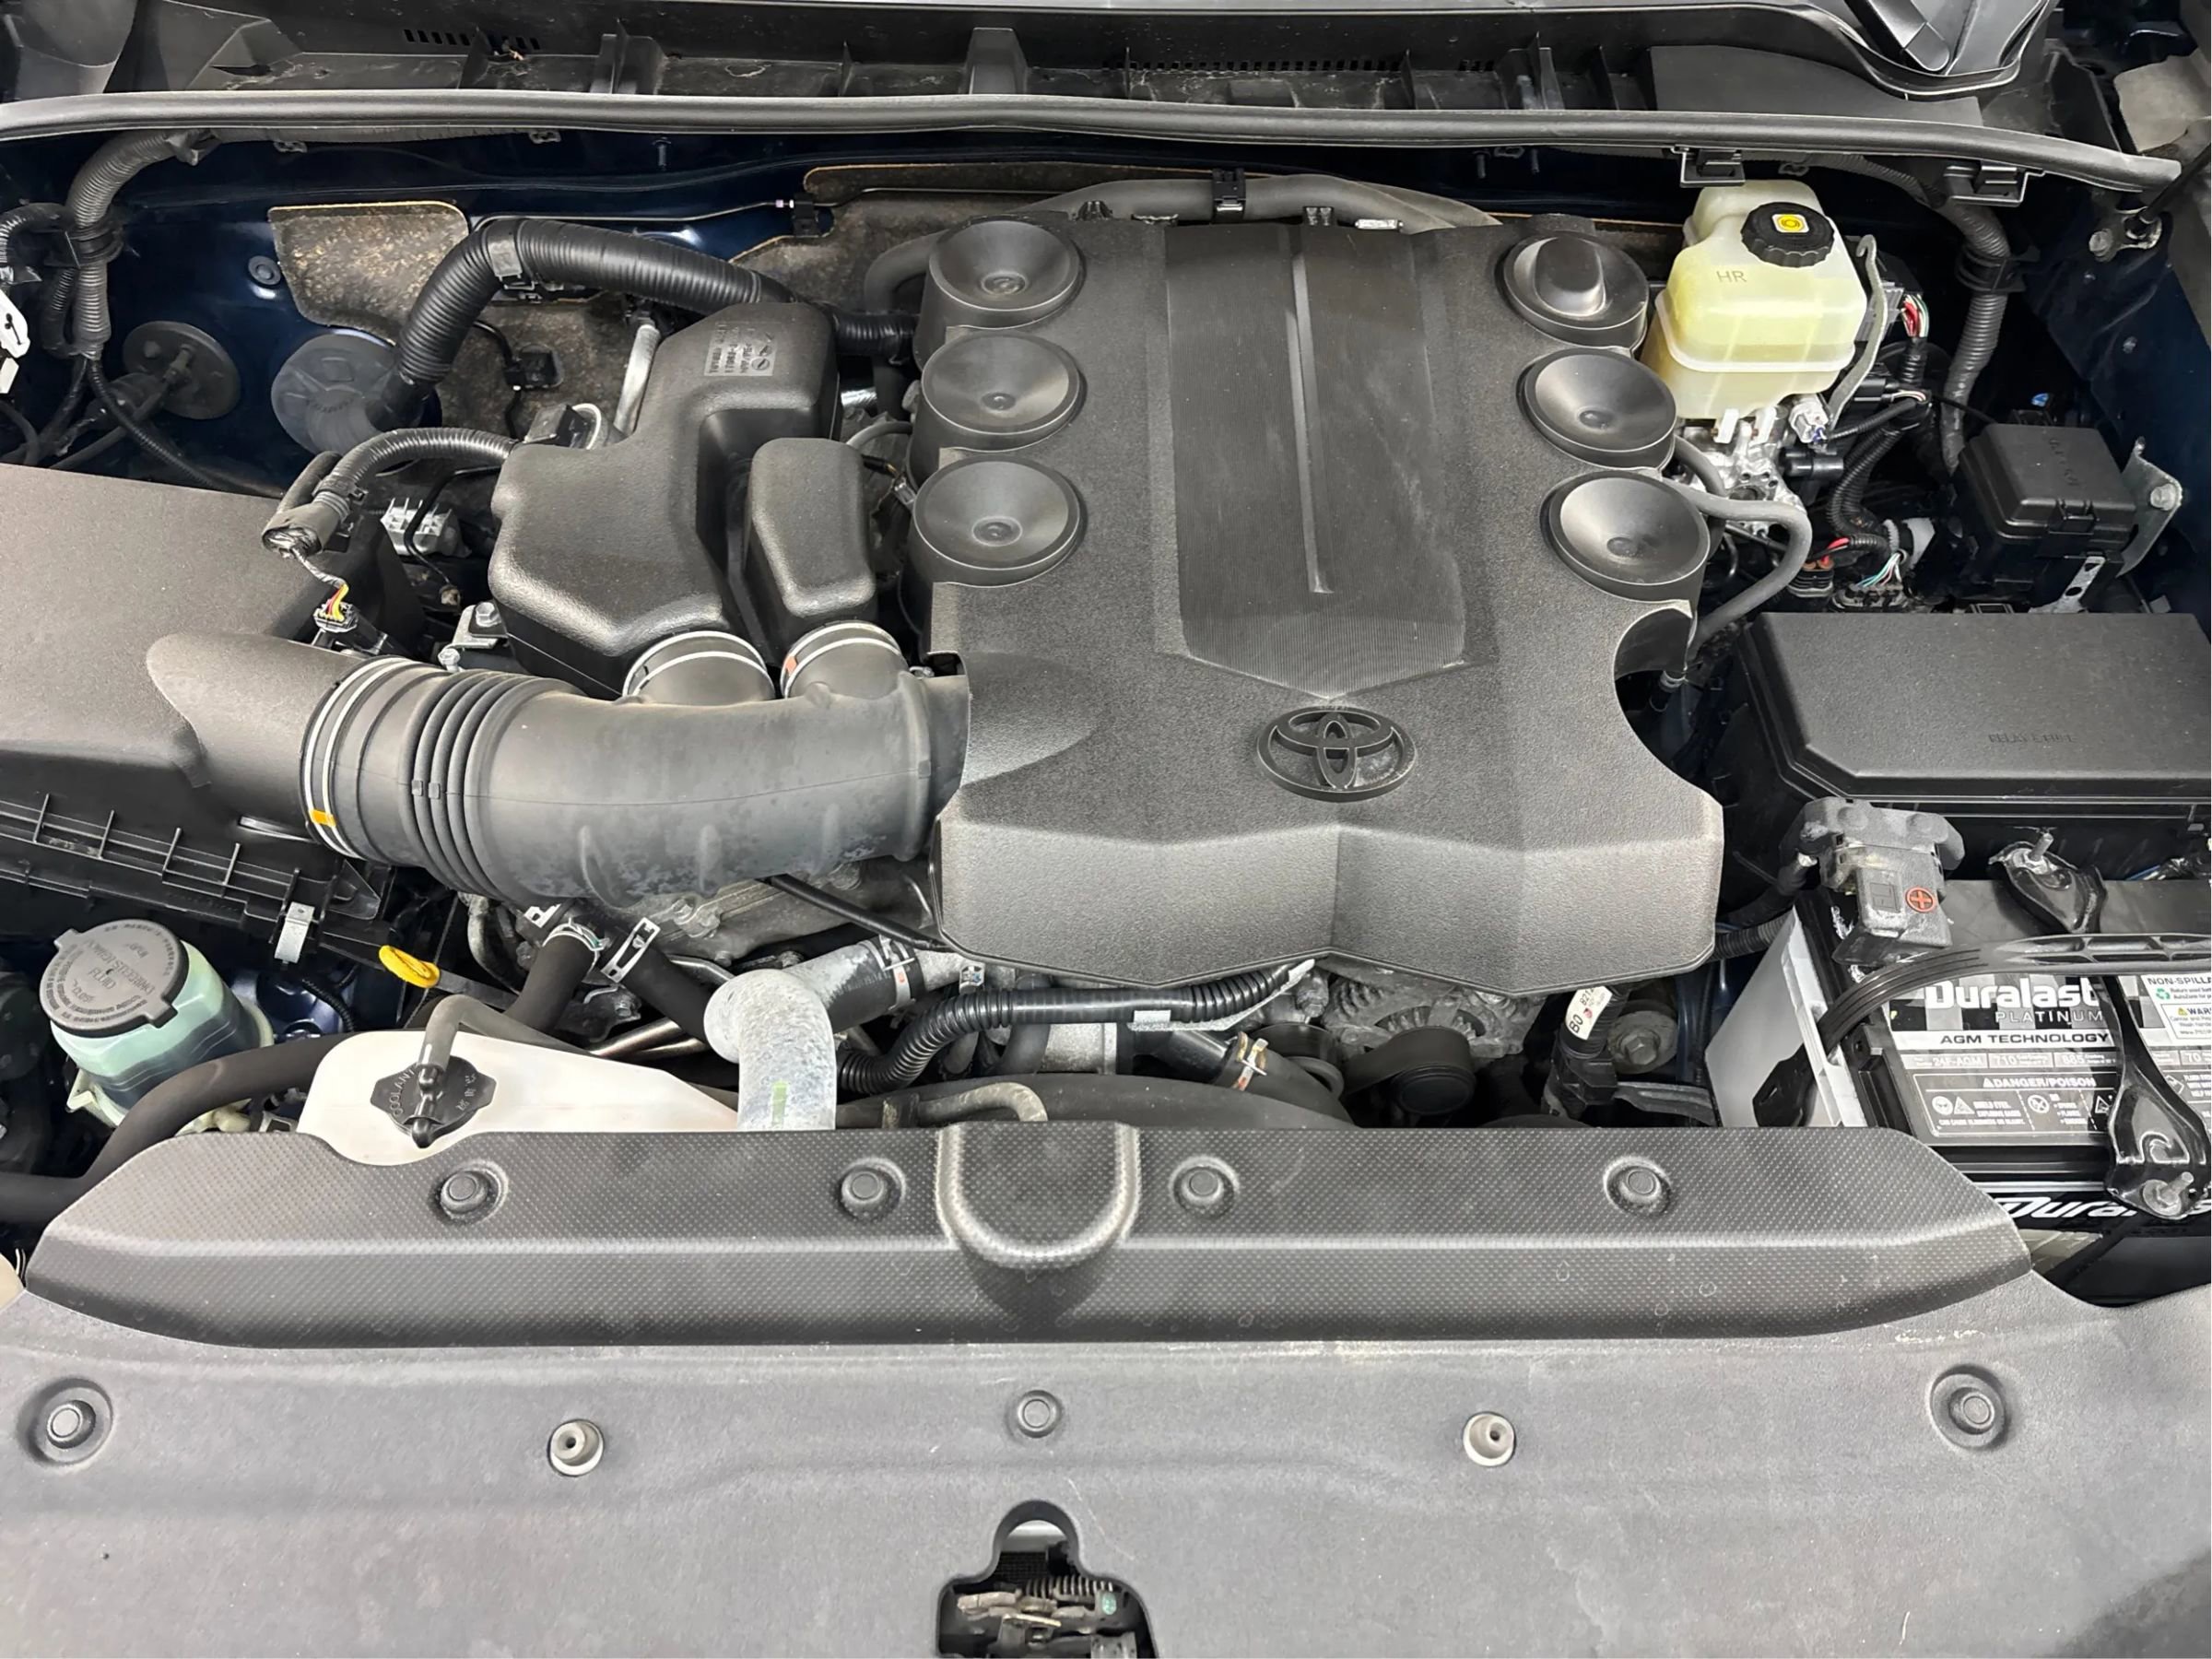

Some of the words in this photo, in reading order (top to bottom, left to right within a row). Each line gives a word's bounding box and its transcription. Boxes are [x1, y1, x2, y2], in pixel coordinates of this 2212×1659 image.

[1716, 270, 1747, 283] HR
[88, 968, 116, 990] FLUID
[1925, 978, 2100, 1009] Duralast
[1995, 1010, 2103, 1023] PLATINUM
[1940, 1034, 1982, 1044] AGM
[1987, 1033, 2109, 1043] TECHNOLOGY
[1994, 1054, 2017, 1065] 710
[2184, 1053, 2202, 1063] 70
[1992, 1077, 2097, 1088] DANGER/POISON
